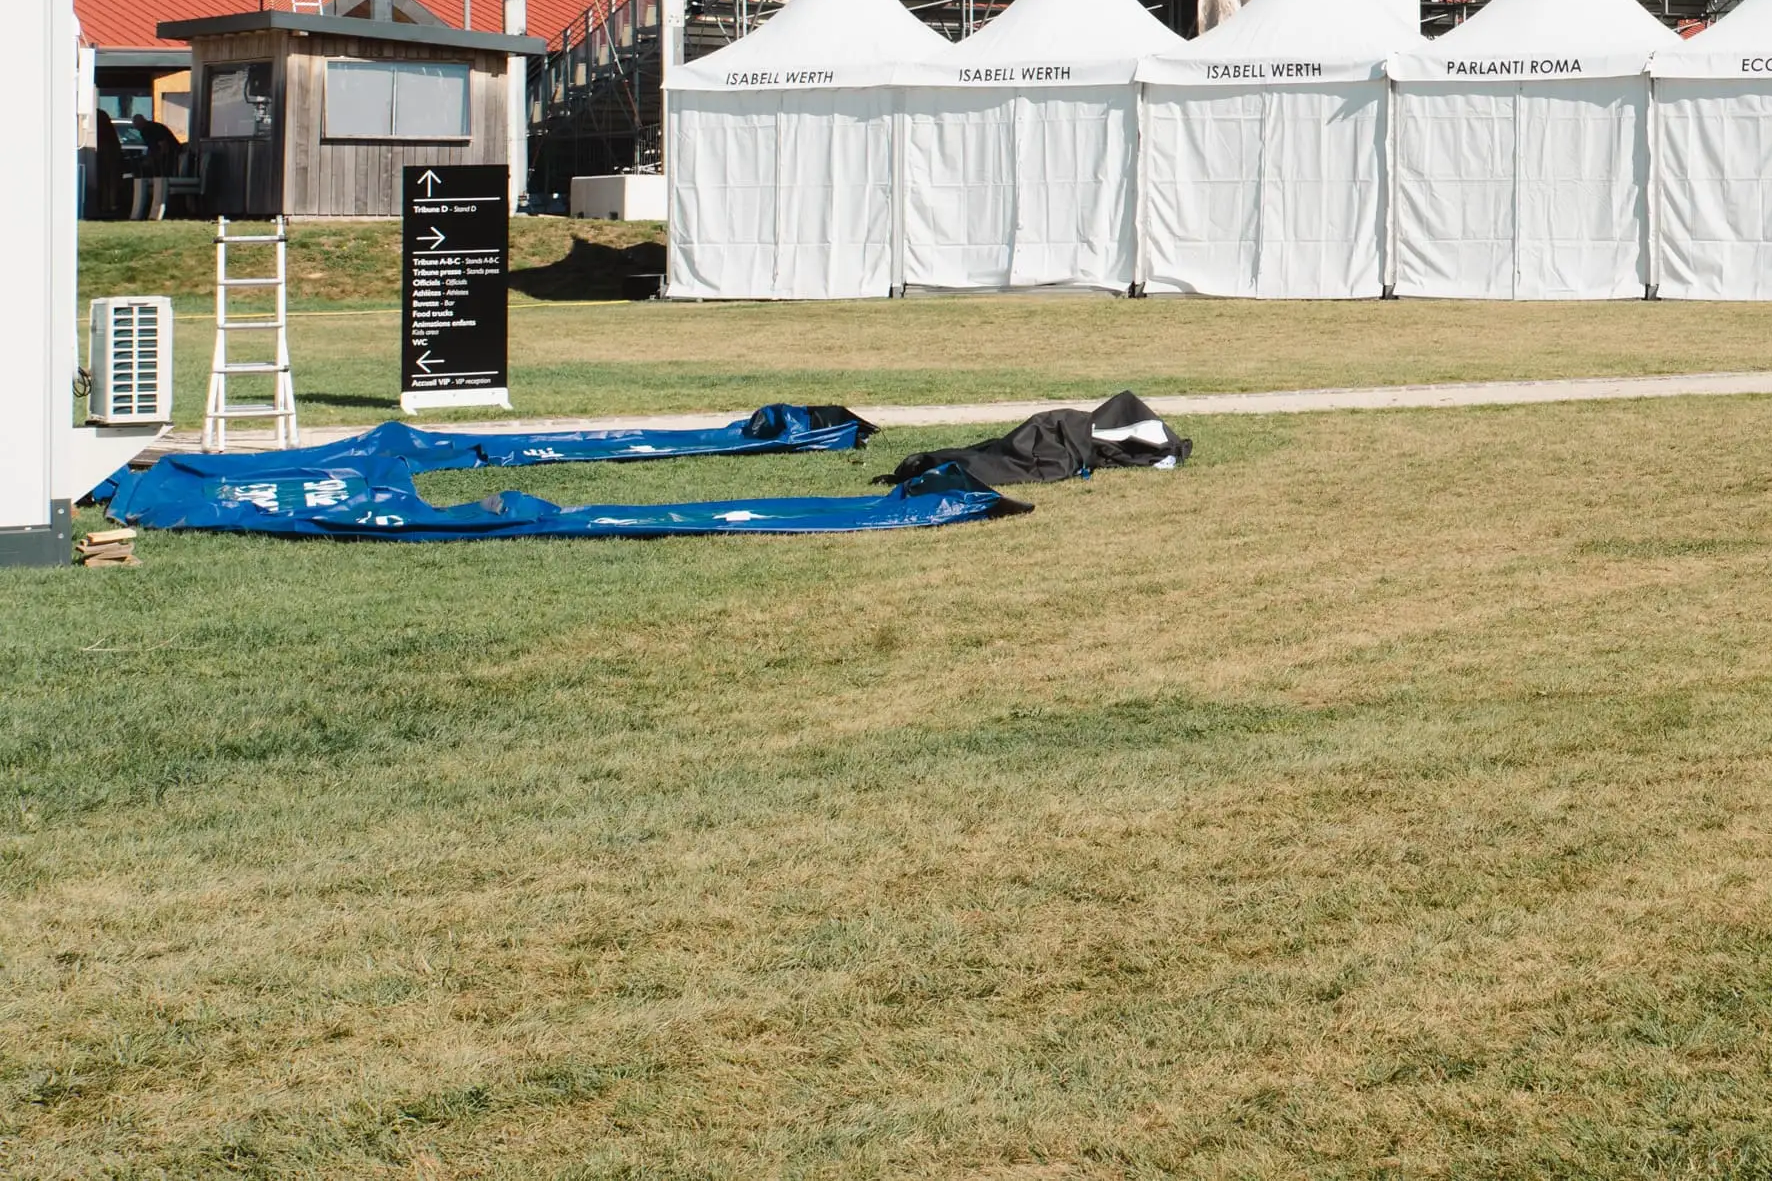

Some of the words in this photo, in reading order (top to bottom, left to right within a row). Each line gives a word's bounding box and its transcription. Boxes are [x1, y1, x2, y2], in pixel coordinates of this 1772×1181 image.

[1207, 64, 1266, 79] ISABELL
[1271, 62, 1322, 78] WERTH
[1447, 60, 1524, 75] PARLANTI
[1530, 58, 1582, 74] ROMA
[725, 72, 780, 86] ISABELL
[786, 70, 834, 84] WERTH
[959, 68, 1015, 82] ISABELL
[1021, 66, 1071, 81] WERTH
[413, 205, 440, 214] Tribune
[441, 205, 449, 213] D
[453, 205, 470, 213] Stand
[412, 258, 439, 266] Tribune
[439, 257, 461, 265] A-B-C
[465, 257, 483, 265] Stands
[440, 269, 462, 277] presse
[412, 279, 441, 287] Officiels
[412, 300, 440, 308] Buvette
[412, 310, 431, 318] Food
[431, 309, 454, 317] trucks
[412, 320, 451, 328] Animations
[452, 319, 477, 327] enfants
[412, 338, 428, 346] WC
[411, 379, 438, 387] Accueil
[438, 378, 451, 386] VIP
